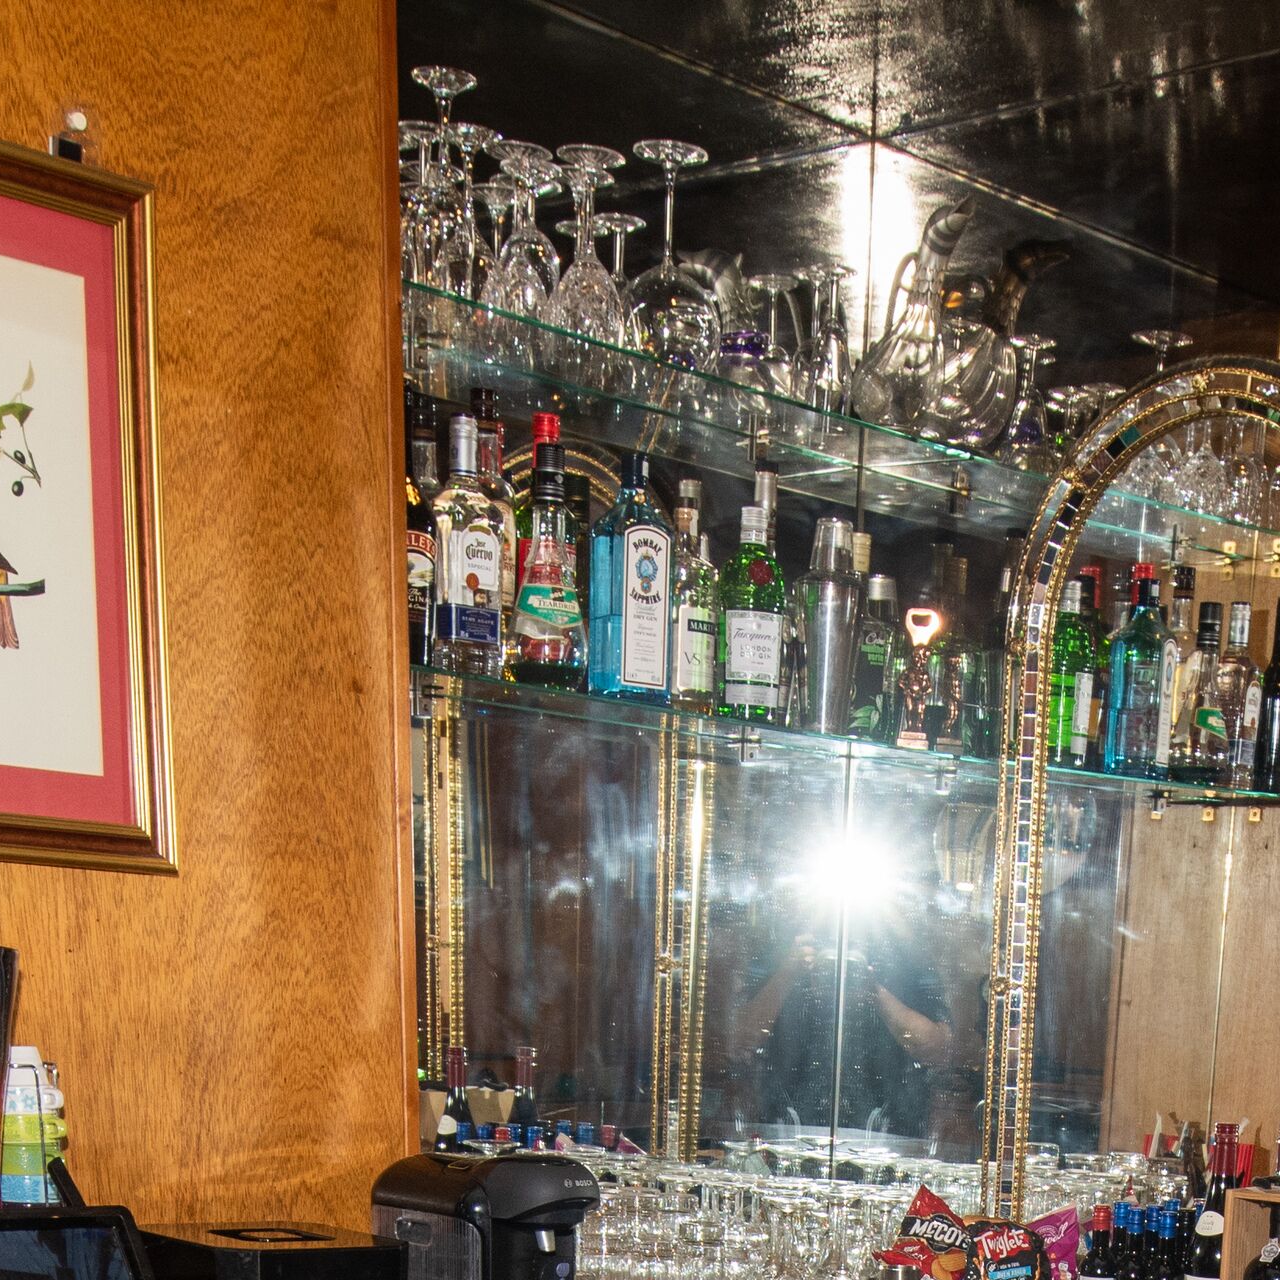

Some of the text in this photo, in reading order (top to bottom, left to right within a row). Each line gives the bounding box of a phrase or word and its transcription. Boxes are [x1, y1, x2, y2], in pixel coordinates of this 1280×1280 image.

[465, 543, 494, 562] Cuervo
[632, 537, 663, 557] BOMBAY
[629, 586, 662, 605] SAPPHIRE
[574, 1179, 593, 1187] BOSCH
